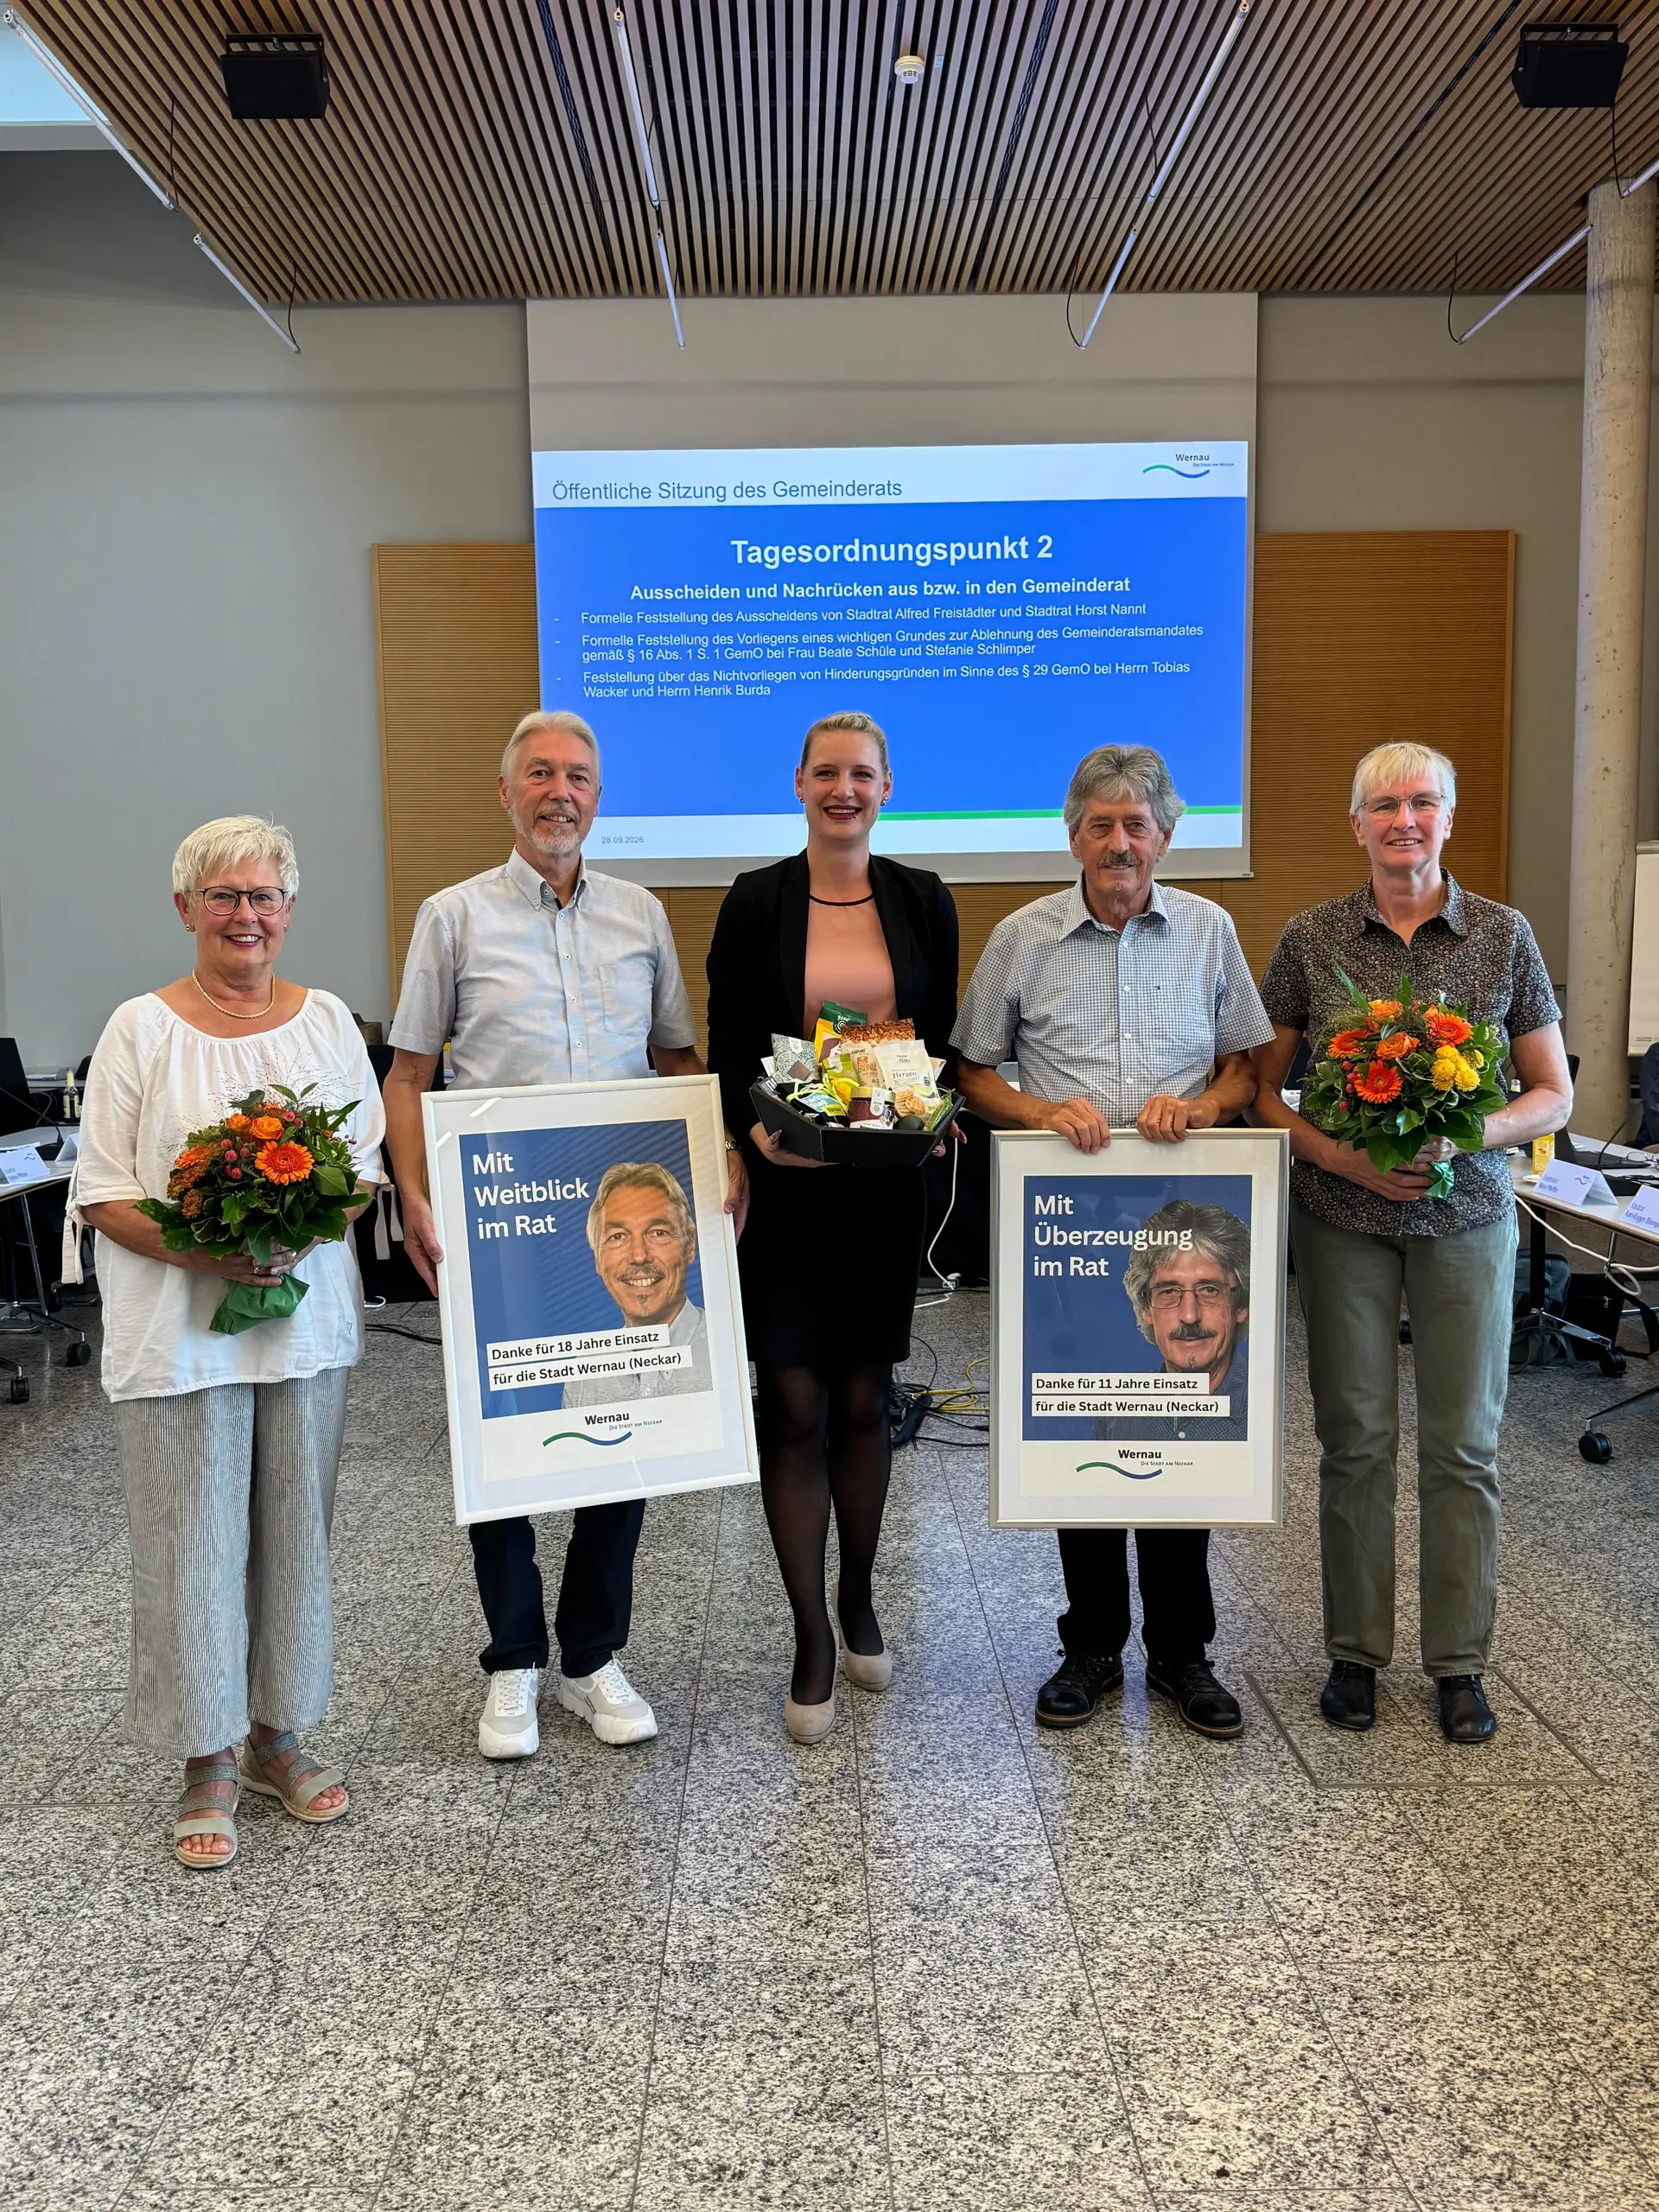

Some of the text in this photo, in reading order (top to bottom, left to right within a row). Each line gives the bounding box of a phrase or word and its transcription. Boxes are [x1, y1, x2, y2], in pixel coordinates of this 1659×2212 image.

[553, 480, 901, 502] Öffentliche Sitzung des Gemeinderats
[731, 535, 1052, 569] Tagesordnungspunkt 2
[631, 578, 1130, 599] Ausscheiden und Nachrücken aus bzw. in den Gemeinderat
[582, 604, 1146, 625] Formelle Feststellung des Ausscheidens von Stadtrat Alfred Freistädter und Stadtrat Horst Nannt
[582, 626, 1203, 647] Formelle Feststellung des Vorliegens eines wichtigen Grundes zur Ablehnung des Gemeinderatsmandates
[582, 644, 1036, 663] gemäß § 16 Abs. 1 S. 1 GemO bei Frau Beate Schüle und Stefanie Schlimper
[583, 671, 654, 684] Feststellung
[658, 671, 685, 682] über
[689, 671, 709, 682] das
[714, 670, 796, 683] Nichtvorliegen
[825, 667, 938, 681] Hinderungsgründen
[944, 667, 957, 677] im
[961, 666, 994, 677] Sinne
[998, 665, 1019, 676] des
[1022, 664, 1029, 677] §
[1033, 664, 1047, 675] 29
[1052, 664, 1090, 675] GemO
[1095, 664, 1111, 674] bei
[1116, 663, 1147, 673] Herrn
[1152, 662, 1190, 672] Tobias
[583, 684, 770, 697] Wacker und Herrn Henrik Burda
[601, 836, 645, 844] 28.09.2026
[473, 1152, 514, 1175] Mit
[474, 1178, 590, 1206] Weitblick
[1035, 1194, 1073, 1215] Mit
[478, 1215, 556, 1239] im Rat
[1034, 1222, 1193, 1250] Überzeugung
[1034, 1256, 1109, 1275] im Rat
[493, 1332, 659, 1360] Danke für 18 Jahre Einsatz
[493, 1351, 682, 1385] für die Stadt Wernau (Neckar)
[1036, 1377, 1198, 1389] Danke für 11 Jahre Einsatz
[1035, 1401, 1219, 1413] für die Stadt Wernau (Neckar)
[585, 1413, 630, 1426] Wernau
[1118, 1449, 1162, 1459] Wernau
